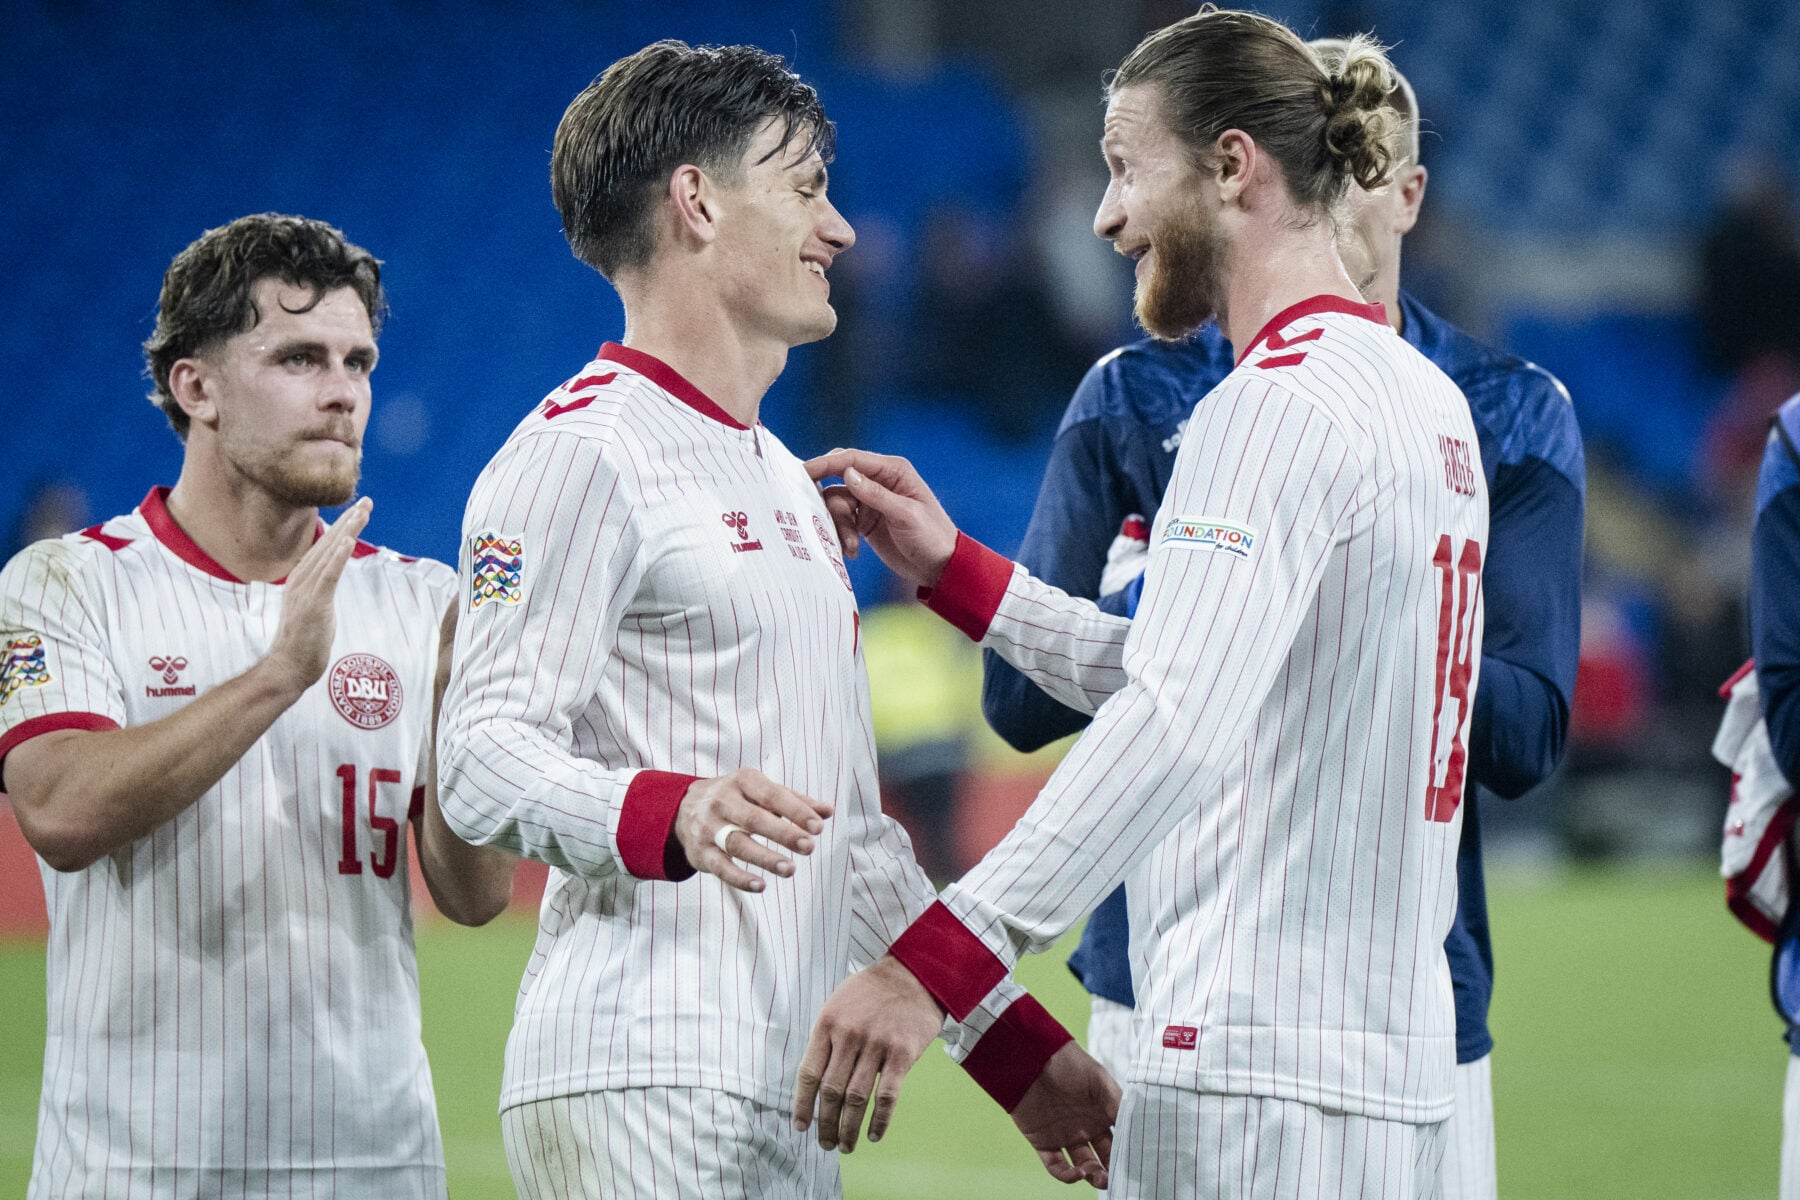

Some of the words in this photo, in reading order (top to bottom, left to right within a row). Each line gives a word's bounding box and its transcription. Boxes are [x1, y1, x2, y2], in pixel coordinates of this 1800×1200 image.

[146, 684, 196, 698] hummel
[346, 677, 389, 701] DBU
[336, 763, 401, 879] 15
